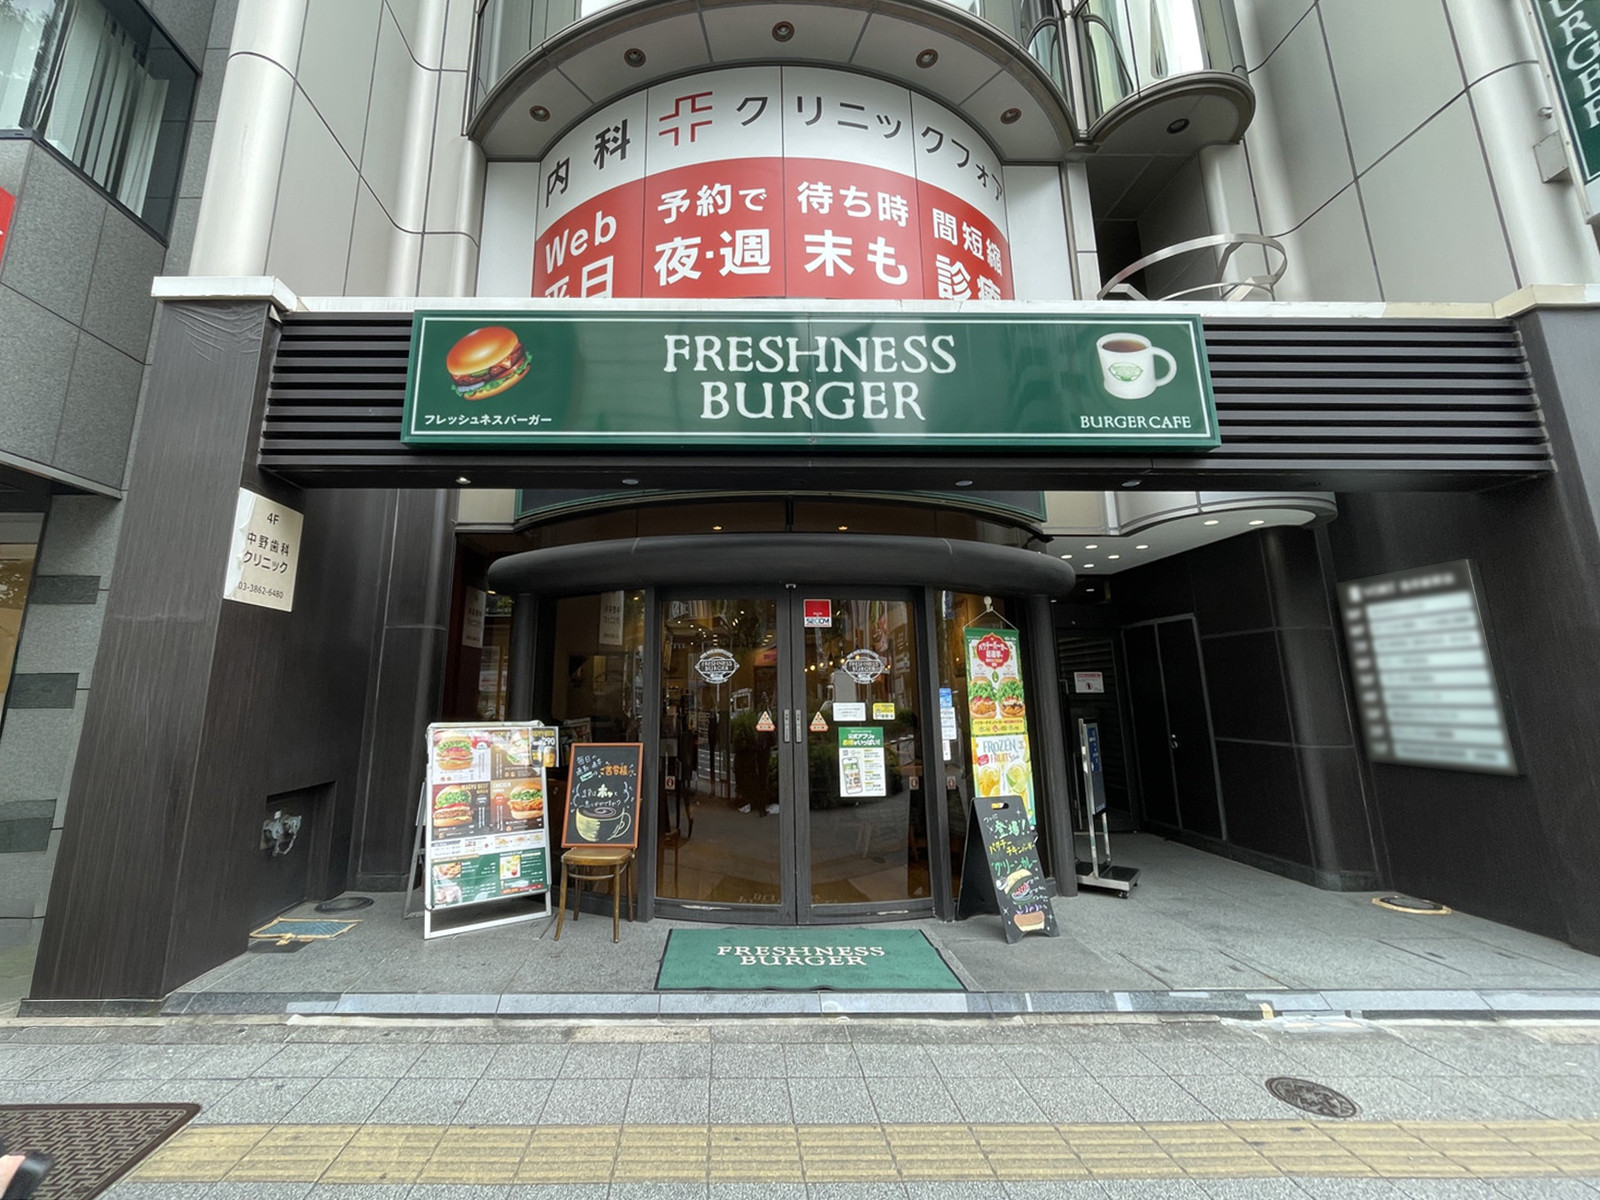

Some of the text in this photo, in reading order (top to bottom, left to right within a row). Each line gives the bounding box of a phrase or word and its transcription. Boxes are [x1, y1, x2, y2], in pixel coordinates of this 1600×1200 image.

[545, 118, 631, 208] 内科
[663, 334, 957, 374] FRESHNESS
[700, 381, 926, 420] BURGER
[424, 414, 552, 426] フレッシュネスバーガー
[1080, 415, 1191, 429] BURGER CAFE
[266, 512, 280, 526] 4F
[247, 531, 290, 557] 中野歯科
[243, 550, 288, 574] クリニック
[237, 581, 284, 599] 03-3862-6480
[716, 946, 886, 957] FRESHNESS
[739, 956, 867, 966] BURGER
